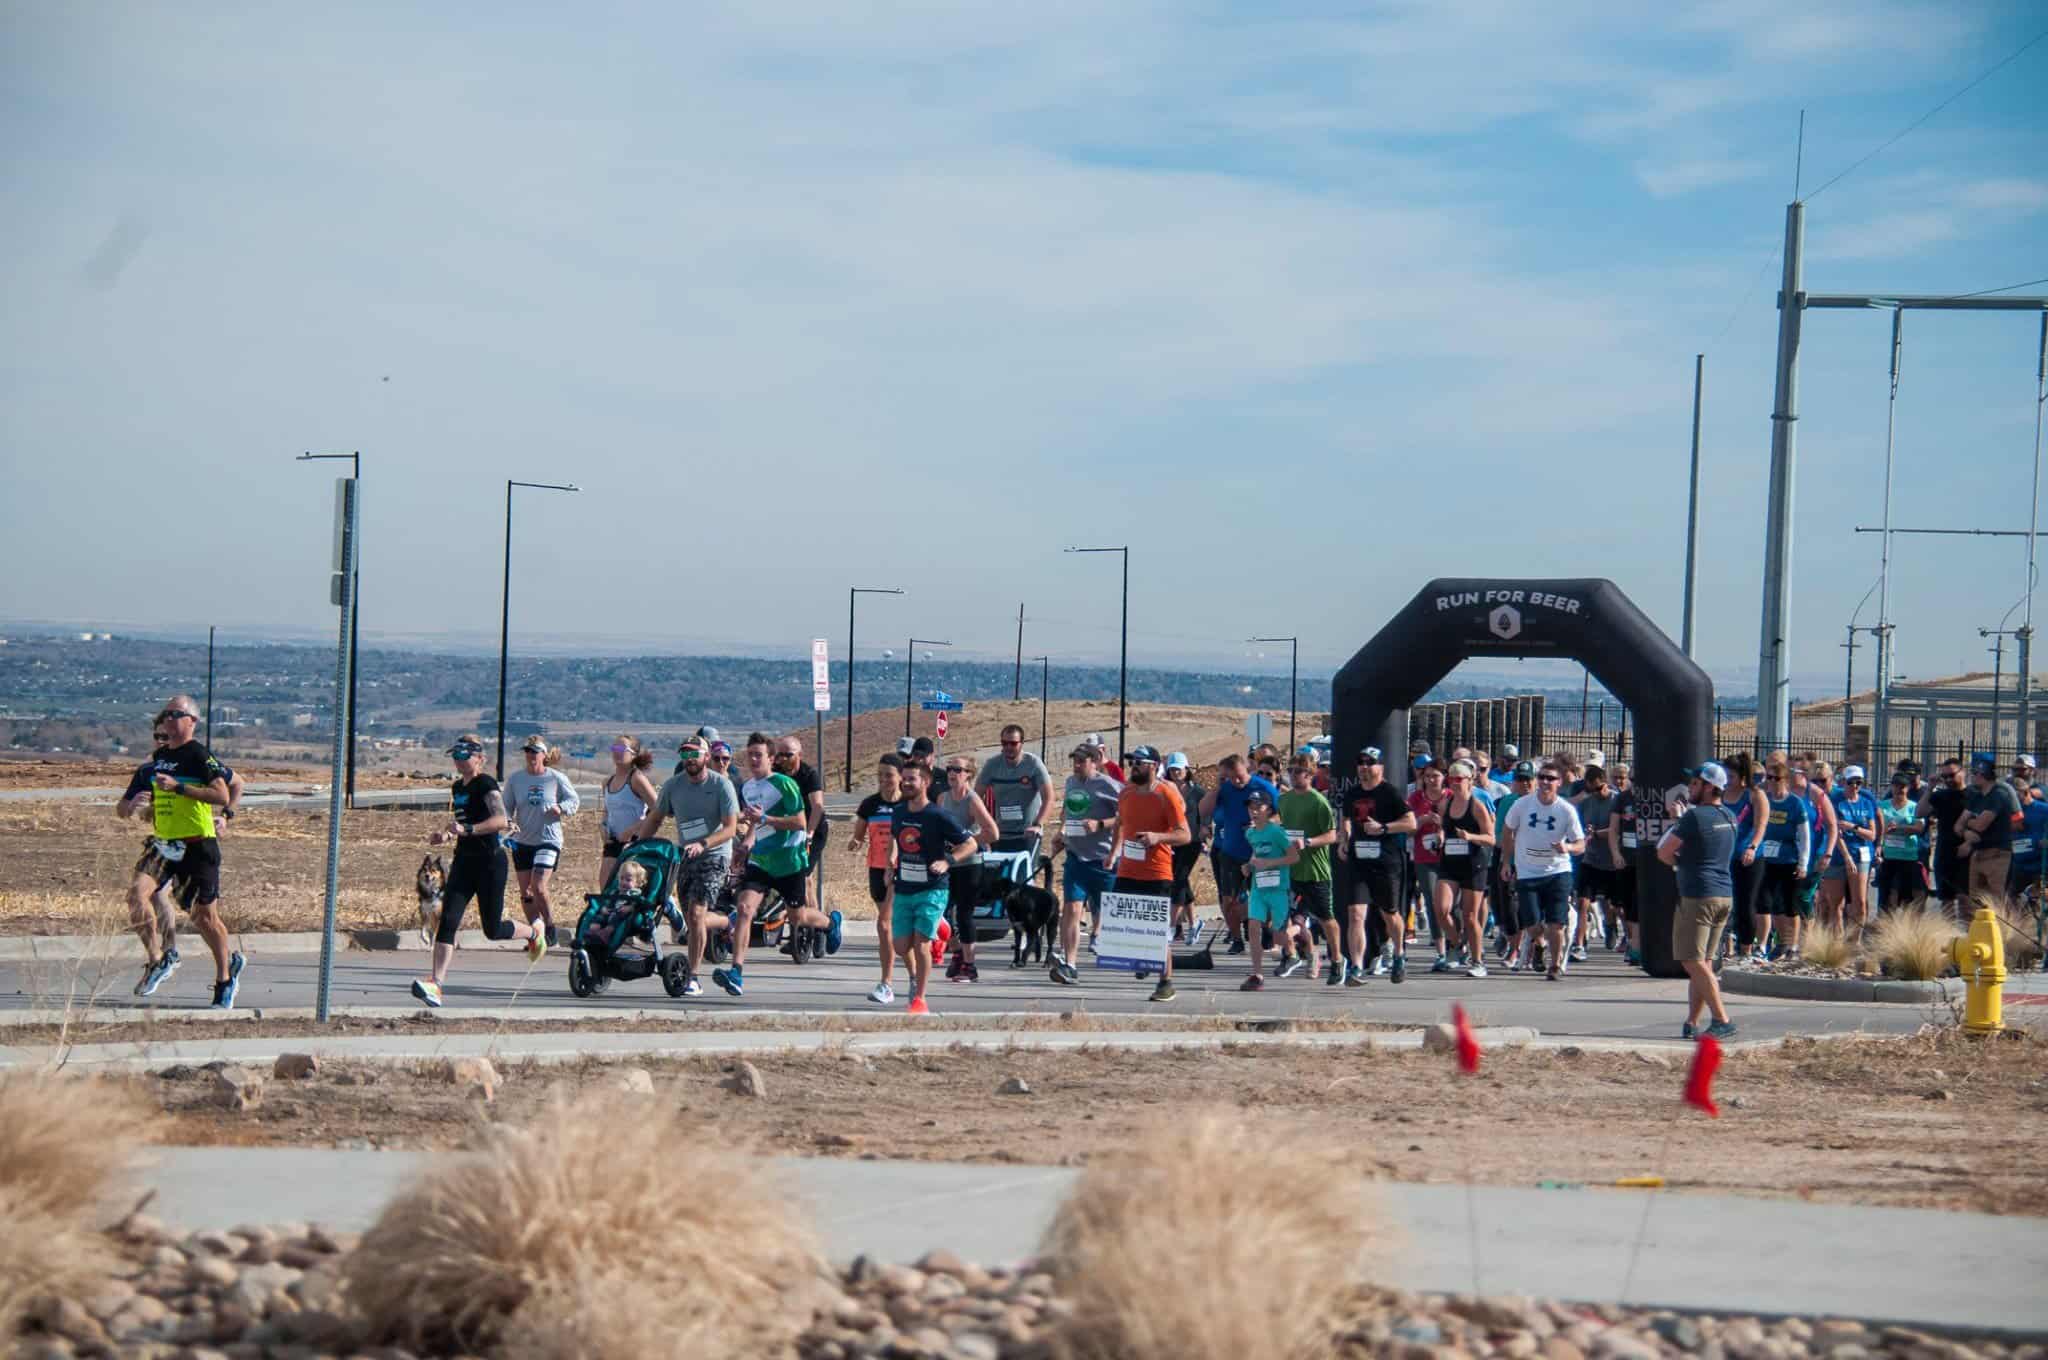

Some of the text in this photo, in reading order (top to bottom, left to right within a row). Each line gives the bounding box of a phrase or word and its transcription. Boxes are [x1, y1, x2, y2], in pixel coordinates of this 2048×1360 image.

[1436, 590, 1581, 614] RUN FOR BEER
[1635, 819, 1676, 841] BE
[1117, 897, 1168, 912] ANYTIME
[1117, 909, 1168, 922] FITNESS
